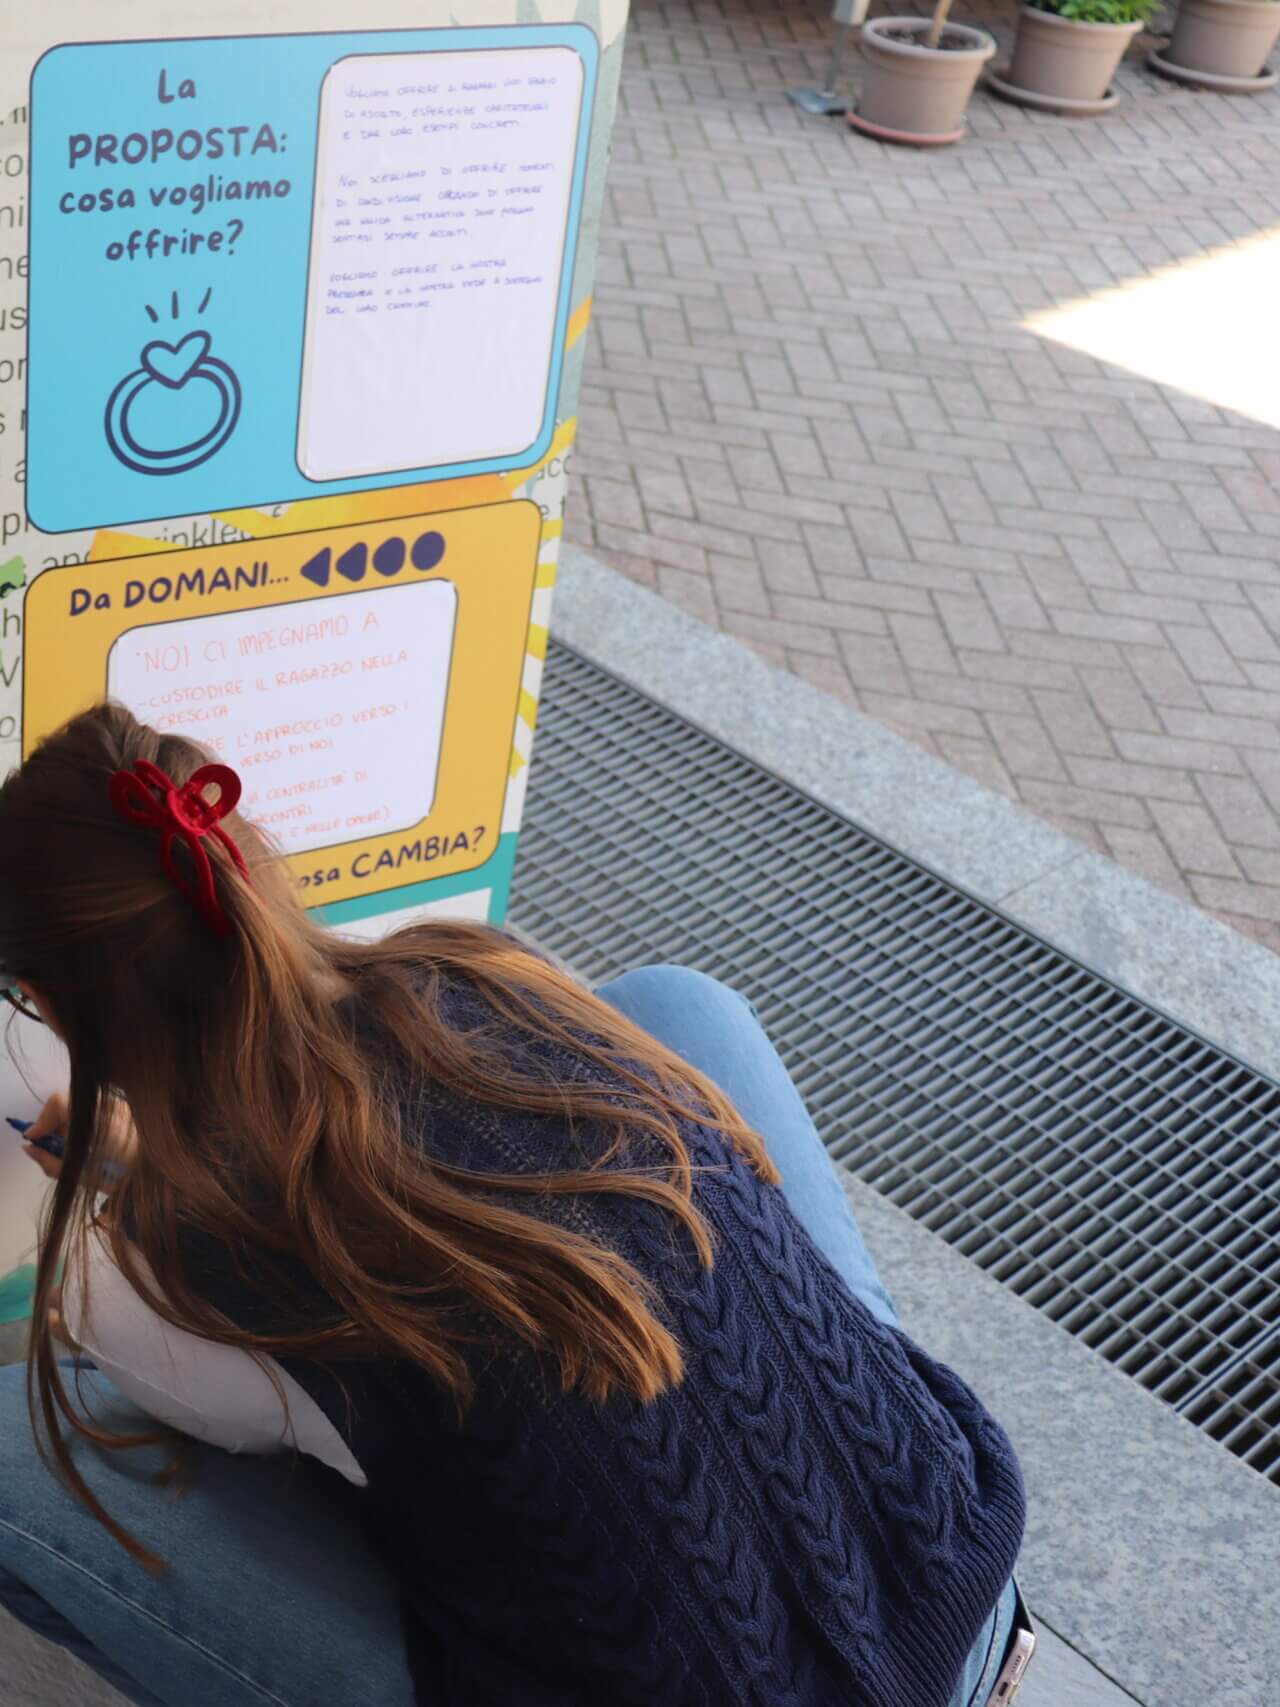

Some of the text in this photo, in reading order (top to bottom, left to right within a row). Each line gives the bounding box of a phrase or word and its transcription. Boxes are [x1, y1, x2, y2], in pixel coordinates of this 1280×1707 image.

[158, 68, 197, 104] La
[69, 123, 287, 169] PROPOSTA:
[59, 175, 291, 214] cosa vogliamo
[106, 219, 244, 261] offrire?
[70, 588, 111, 616] Da
[203, 640, 226, 662] CI
[362, 612, 381, 633] A
[300, 826, 487, 888] osa CAMBIA?
